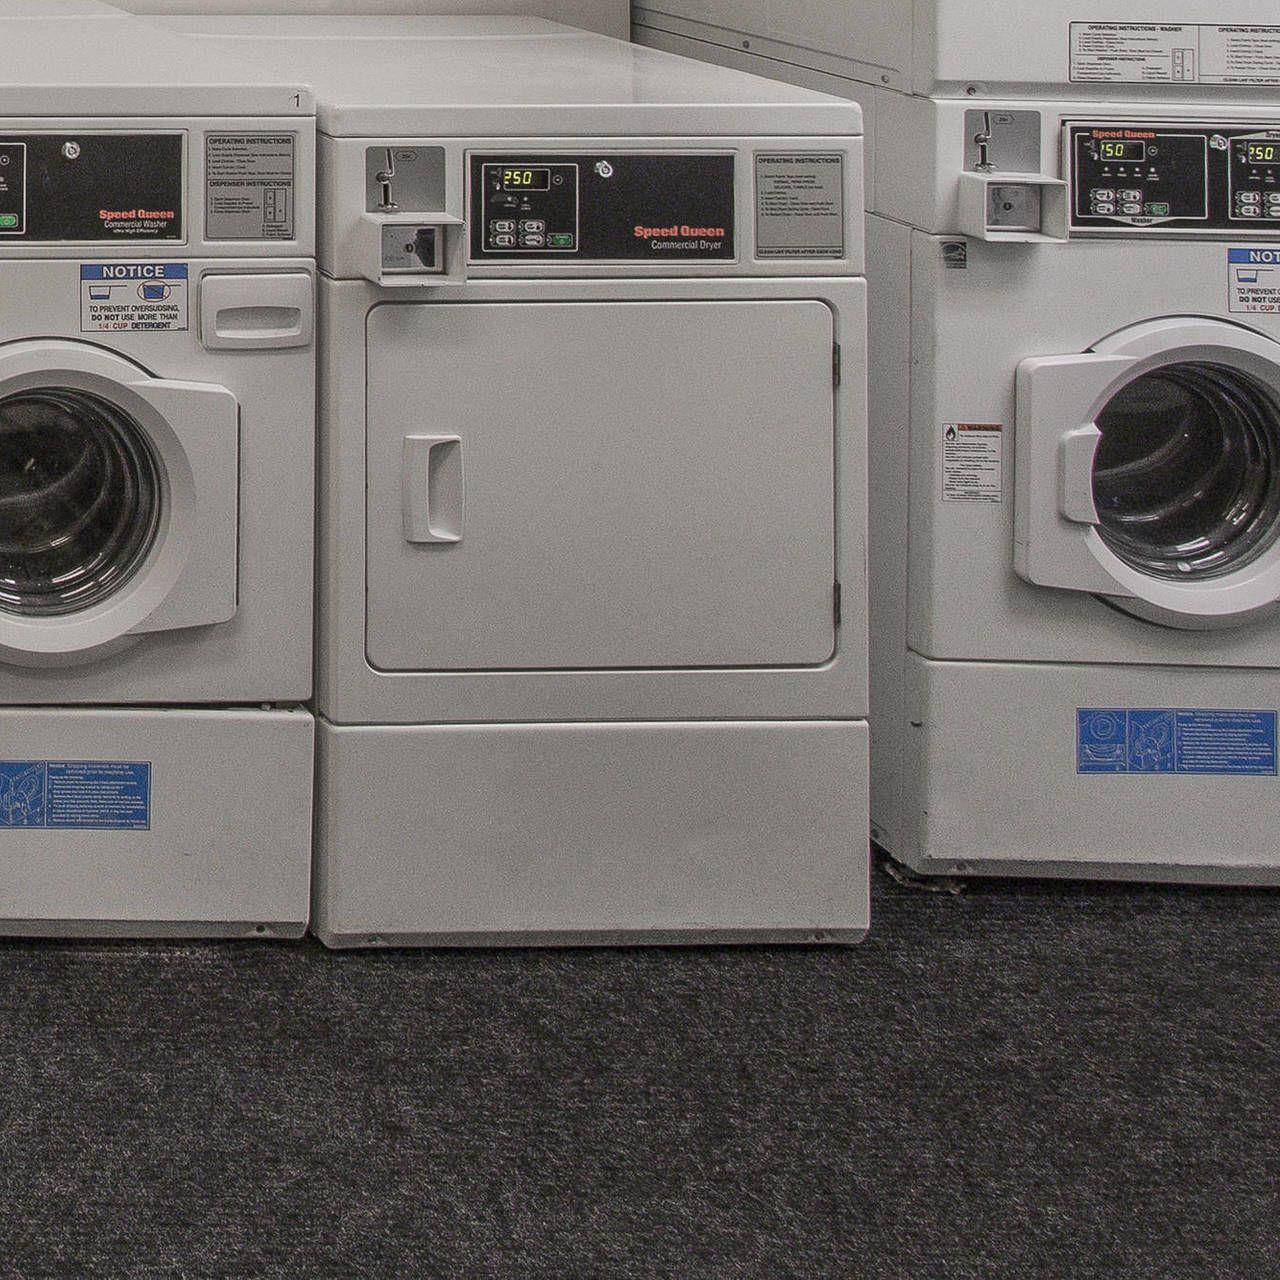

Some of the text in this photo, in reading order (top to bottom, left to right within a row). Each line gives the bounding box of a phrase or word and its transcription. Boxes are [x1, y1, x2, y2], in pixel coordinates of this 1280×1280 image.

[1092, 130, 1155, 139] Speed Queen
[1101, 144, 1124, 156] 50
[504, 171, 532, 185] 250
[99, 209, 175, 220] Speed Queen
[104, 220, 168, 229] Commercial Washer
[633, 225, 725, 239] Speed Queen
[651, 240, 721, 250] Commercial Dryer
[102, 265, 165, 278] NOTICE
[1246, 287, 1276, 295] PREVENT
[159, 313, 178, 321] THAN
